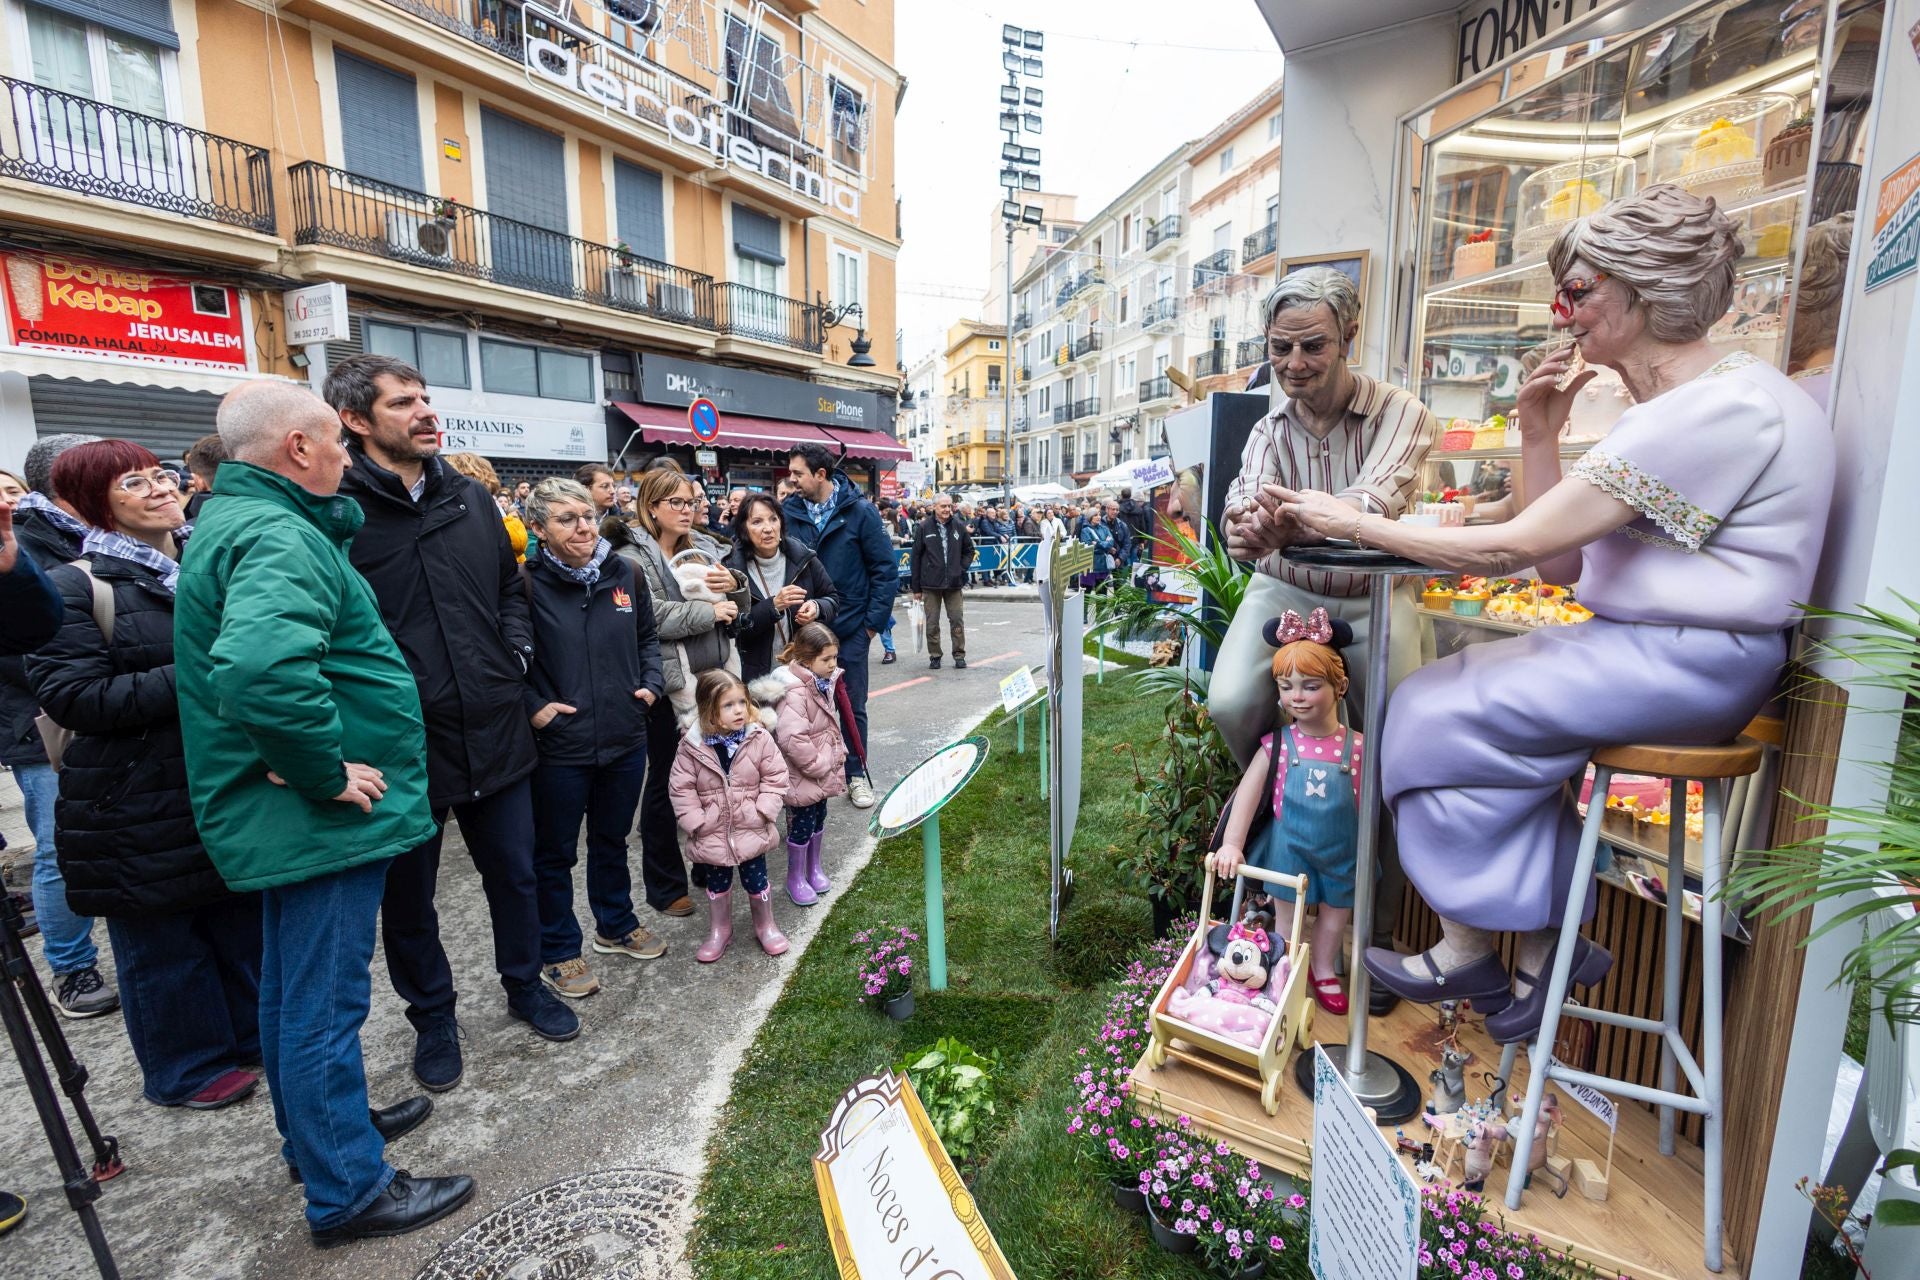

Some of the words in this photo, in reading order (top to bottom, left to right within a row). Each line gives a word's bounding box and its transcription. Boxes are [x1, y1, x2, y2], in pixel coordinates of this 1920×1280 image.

[528, 38, 861, 217] aerotermia
[48, 281, 163, 321] Kebap
[18, 328, 89, 346] COMIDA
[95, 336, 146, 352] HALAL
[128, 322, 242, 349] JERUSALEM
[313, 328, 320, 337] 57
[321, 326, 329, 336] 23
[817, 397, 864, 417] StarPhone
[438, 416, 524, 436] ERMANIES
[863, 1145, 909, 1244] Noces
